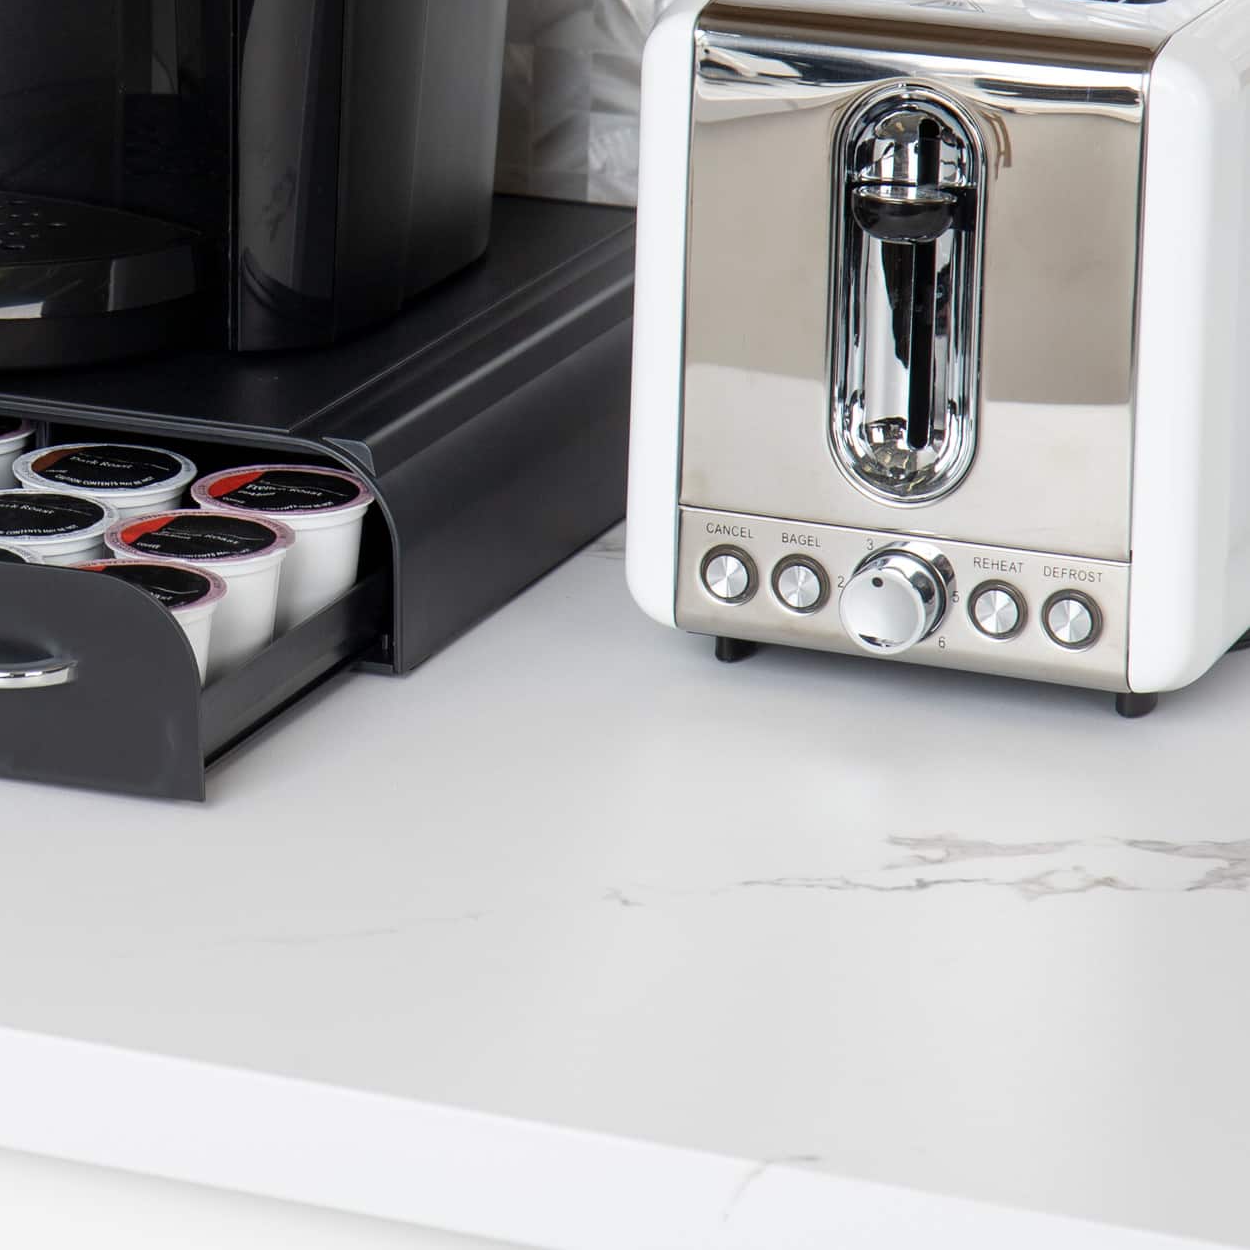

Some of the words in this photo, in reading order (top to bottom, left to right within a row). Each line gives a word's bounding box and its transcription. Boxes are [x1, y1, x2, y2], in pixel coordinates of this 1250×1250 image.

[705, 521, 754, 539] CANCEL
[781, 532, 822, 548] BAGEL
[866, 538, 875, 551] 3
[973, 556, 1024, 574] REHEAT
[1043, 565, 1103, 583] DEFROST
[837, 575, 846, 589] 2
[951, 591, 960, 603] 5
[938, 635, 947, 649] 6
